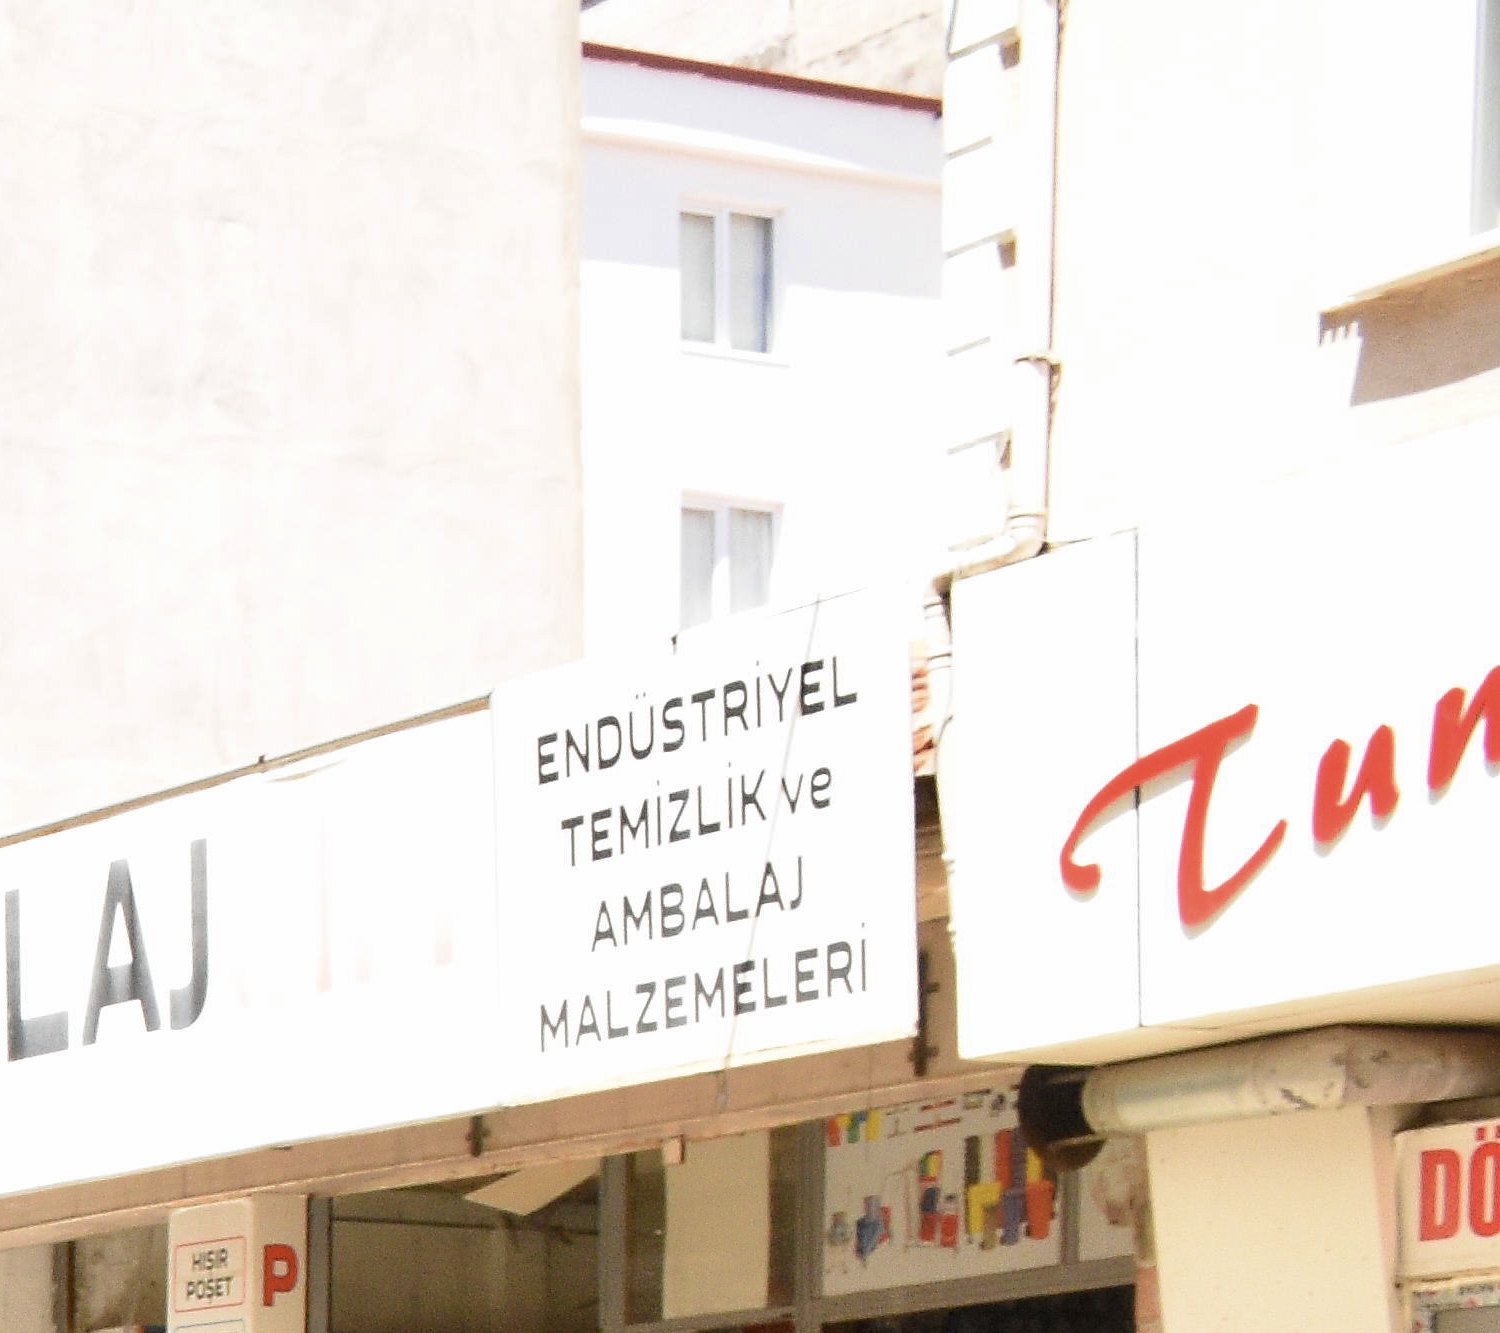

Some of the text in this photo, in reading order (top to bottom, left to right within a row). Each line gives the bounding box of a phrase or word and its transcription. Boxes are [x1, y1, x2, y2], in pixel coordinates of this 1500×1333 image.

[536, 655, 858, 785] ENDÜSTRİYEL
[560, 762, 833, 868] TEMİZLİK ve
[590, 856, 804, 953] AMBALAJ
[539, 921, 869, 1052] MALZEMELERİ
